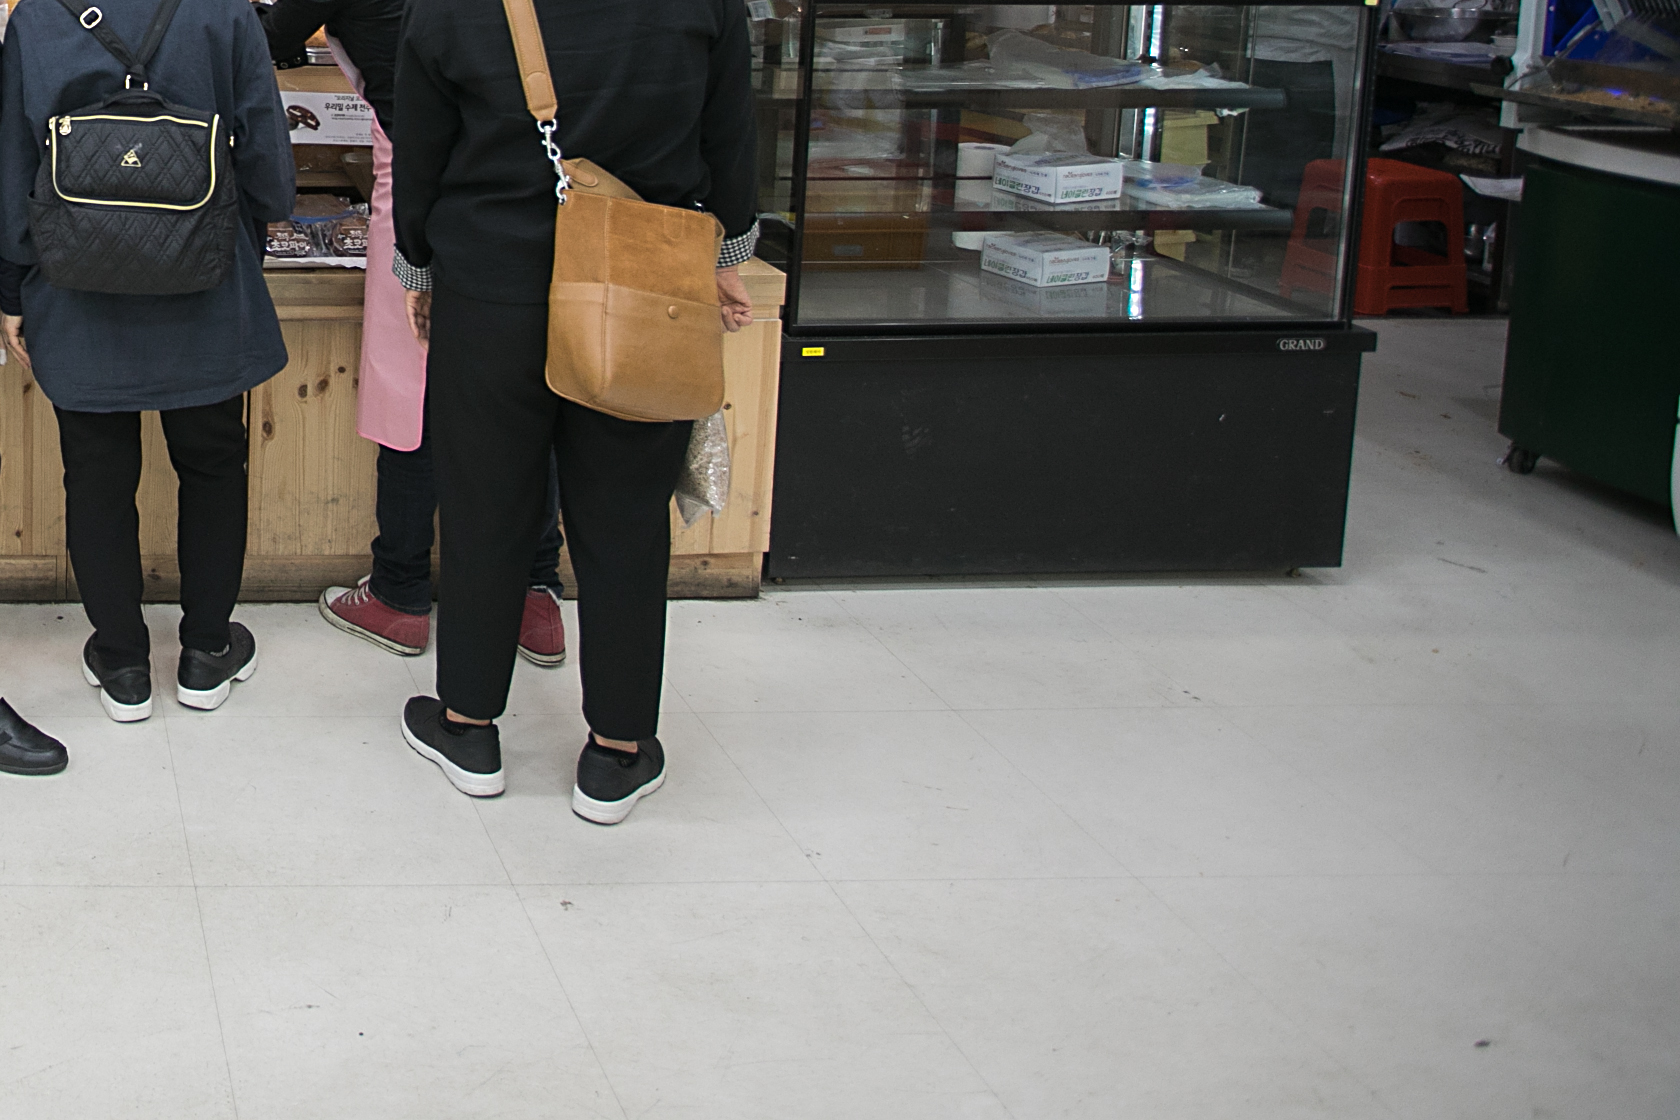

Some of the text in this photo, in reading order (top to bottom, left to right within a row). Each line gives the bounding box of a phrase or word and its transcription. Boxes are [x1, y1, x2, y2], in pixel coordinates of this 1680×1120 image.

[324, 102, 344, 111] 우리밀
[345, 103, 358, 111] 수제
[270, 241, 308, 252] 초코파이
[1279, 339, 1324, 350] GRAND
